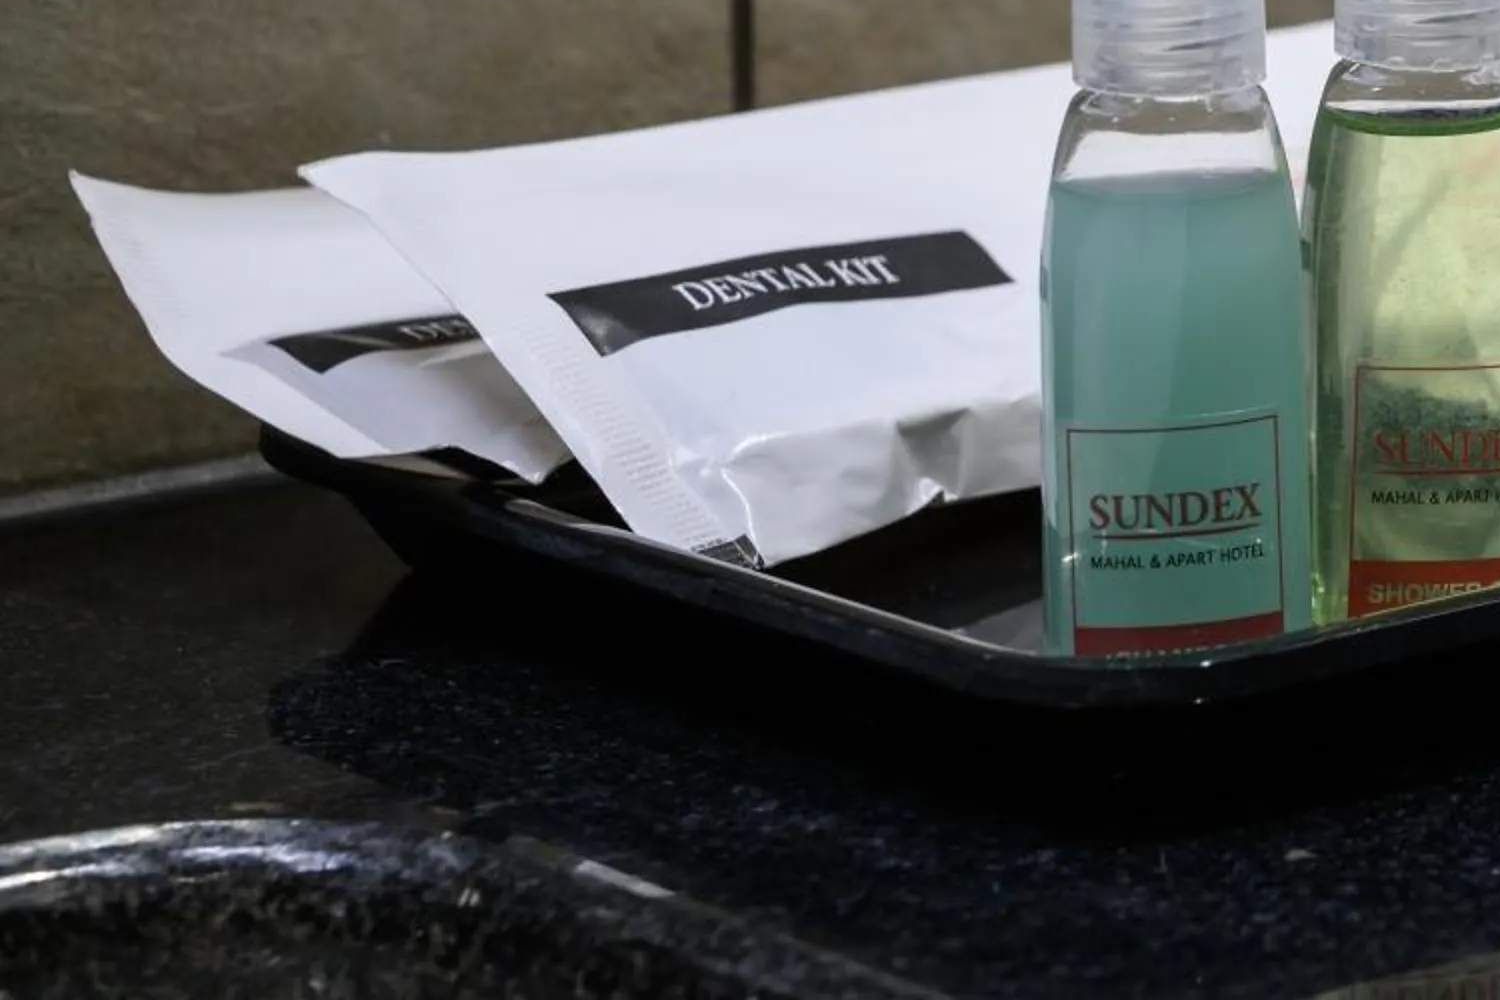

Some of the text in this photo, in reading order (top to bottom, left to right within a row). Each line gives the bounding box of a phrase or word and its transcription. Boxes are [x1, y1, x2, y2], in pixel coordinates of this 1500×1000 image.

[671, 253, 901, 312] DENTAL KIT
[1088, 482, 1263, 531] SUNDEX
[1371, 490, 1426, 505] MAHAL
[1428, 490, 1441, 505] &
[1090, 542, 1265, 570] MAHAL & APART HOTEL
